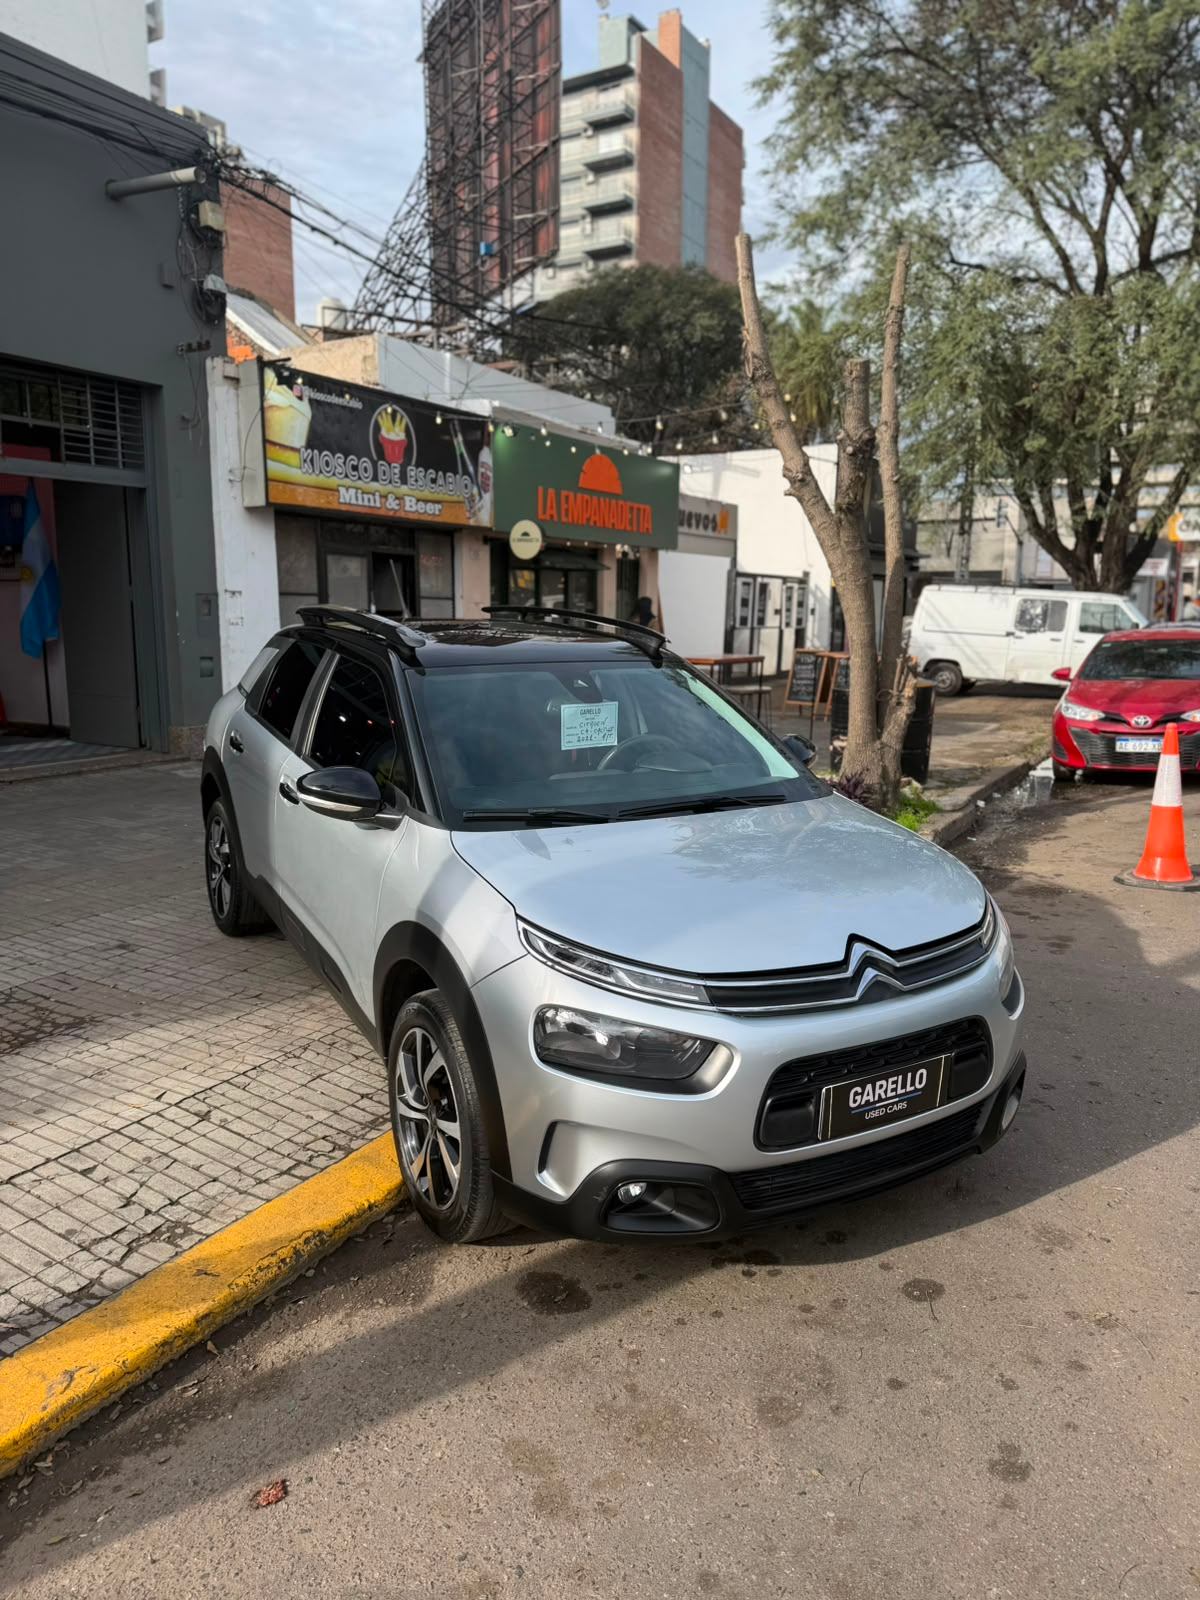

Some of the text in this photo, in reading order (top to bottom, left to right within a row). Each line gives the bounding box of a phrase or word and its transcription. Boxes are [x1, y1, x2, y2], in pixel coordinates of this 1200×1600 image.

[300, 448, 373, 483] KIOSCO
[378, 463, 401, 487] DE
[407, 465, 474, 498] ESCABIO
[338, 486, 442, 515] Mini & Beer
[537, 486, 653, 535] LA EMPANADETTA
[849, 1068, 928, 1108] GARELLO
[864, 1102, 908, 1120] USED CARS
